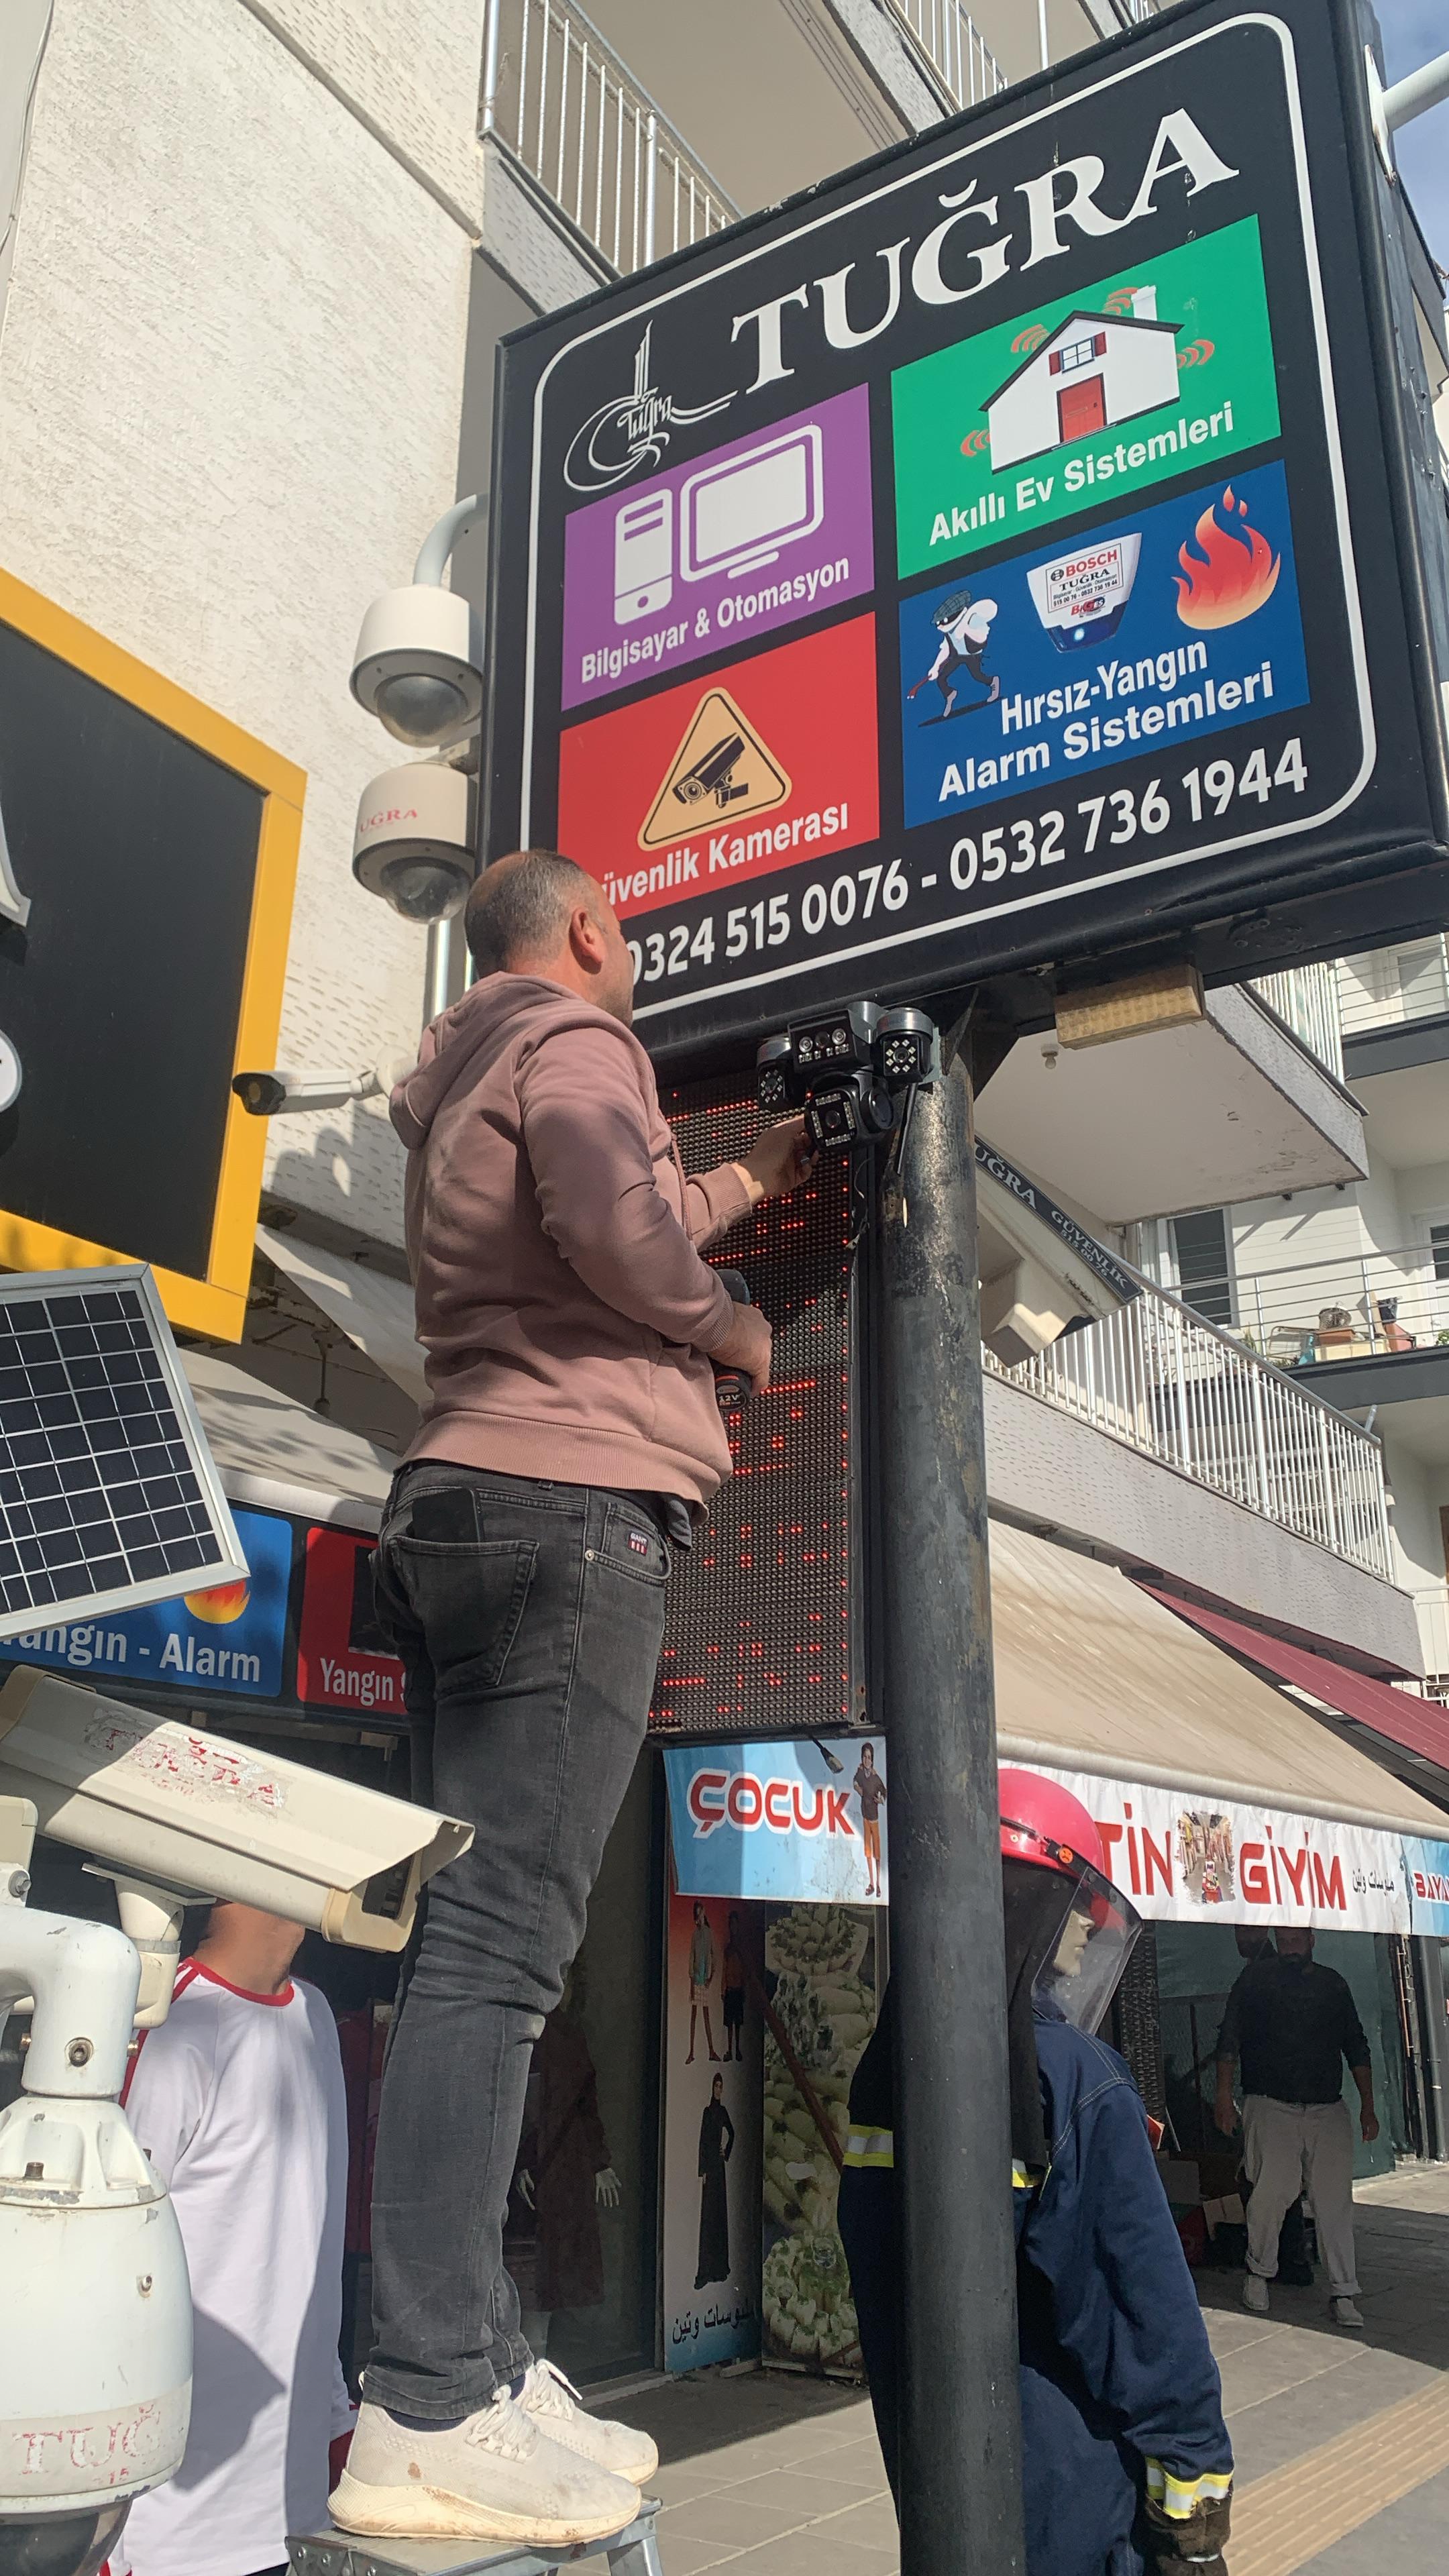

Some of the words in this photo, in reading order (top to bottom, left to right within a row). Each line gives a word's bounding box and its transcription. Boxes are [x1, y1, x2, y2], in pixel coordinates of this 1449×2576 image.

[730, 107, 1240, 395] TUĞRA
[928, 492, 1006, 546] Akıllı
[1016, 476, 1055, 512] Ev
[1064, 400, 1234, 492] Sistemleri
[1059, 568, 1110, 591] TUĞRA
[1065, 549, 1118, 577] BOSCH
[581, 621, 689, 684] Bilgisayar
[694, 607, 710, 638] &
[716, 557, 849, 628] Otomasyon
[938, 743, 1050, 802] Alarm
[1063, 660, 1273, 760] Sistemleri
[1001, 641, 1208, 735] Hırsız-Yangın
[360, 808, 418, 833] UĞRA
[601, 847, 700, 906] üvenlik
[708, 803, 848, 873] Kamerası
[724, 893, 790, 958] 515
[801, 858, 909, 935] 0076
[920, 873, 937, 889] -
[950, 810, 1065, 890] 0532
[1077, 779, 1170, 853] 736
[1181, 737, 1308, 822] 1944
[974, 1143, 1036, 1210] UĞRA
[1051, 1210, 1128, 1289] GÜVENLİK
[1060, 1228, 1079, 1248] 515
[1081, 1248, 1094, 1262] 00
[1095, 1262, 1108, 1277] 76
[2, 1625, 127, 1666] angın
[158, 1632, 261, 1683] Alarm
[319, 1657, 394, 1707] Yangın
[688, 1772, 857, 1837] ÇOCUK
[1095, 1802, 1175, 1897] TİN
[1239, 1825, 1347, 1911] GİYİM
[1413, 1872, 1449, 1902] BAYA
